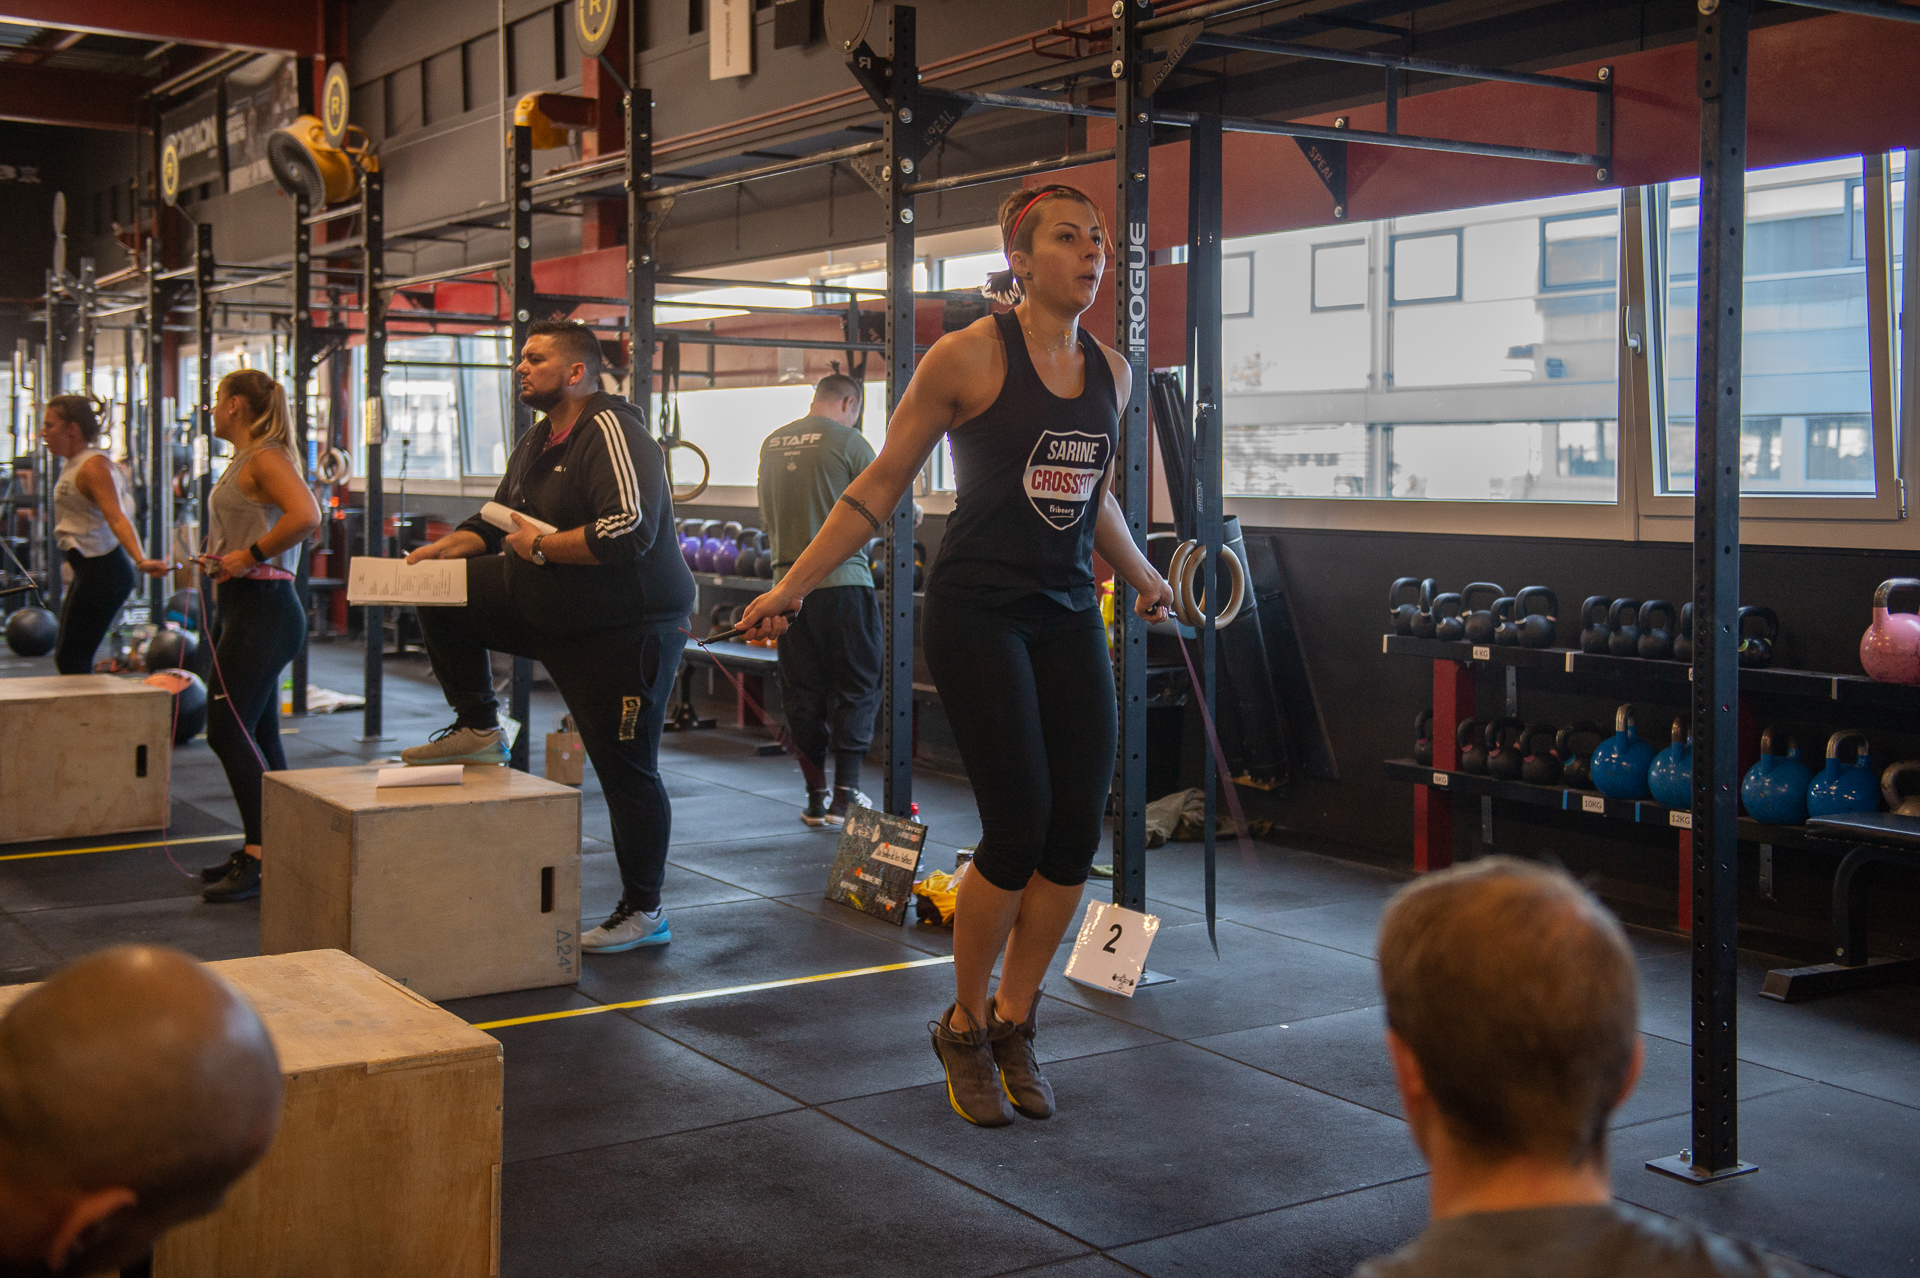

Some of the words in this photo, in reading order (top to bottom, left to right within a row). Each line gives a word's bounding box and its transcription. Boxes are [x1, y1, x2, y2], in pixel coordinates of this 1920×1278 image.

[331, 96, 340, 115] R
[1308, 146, 1333, 183] SPEAL
[1129, 223, 1146, 345] ROGUE
[768, 433, 822, 448] STAFF
[1047, 440, 1100, 463] SARINE
[1031, 469, 1094, 494] CROSSFIT
[1049, 504, 1074, 516] Fribourg
[1584, 800, 1602, 810] 10KG
[1671, 814, 1691, 825] 12KG
[1102, 923, 1123, 954] 2
